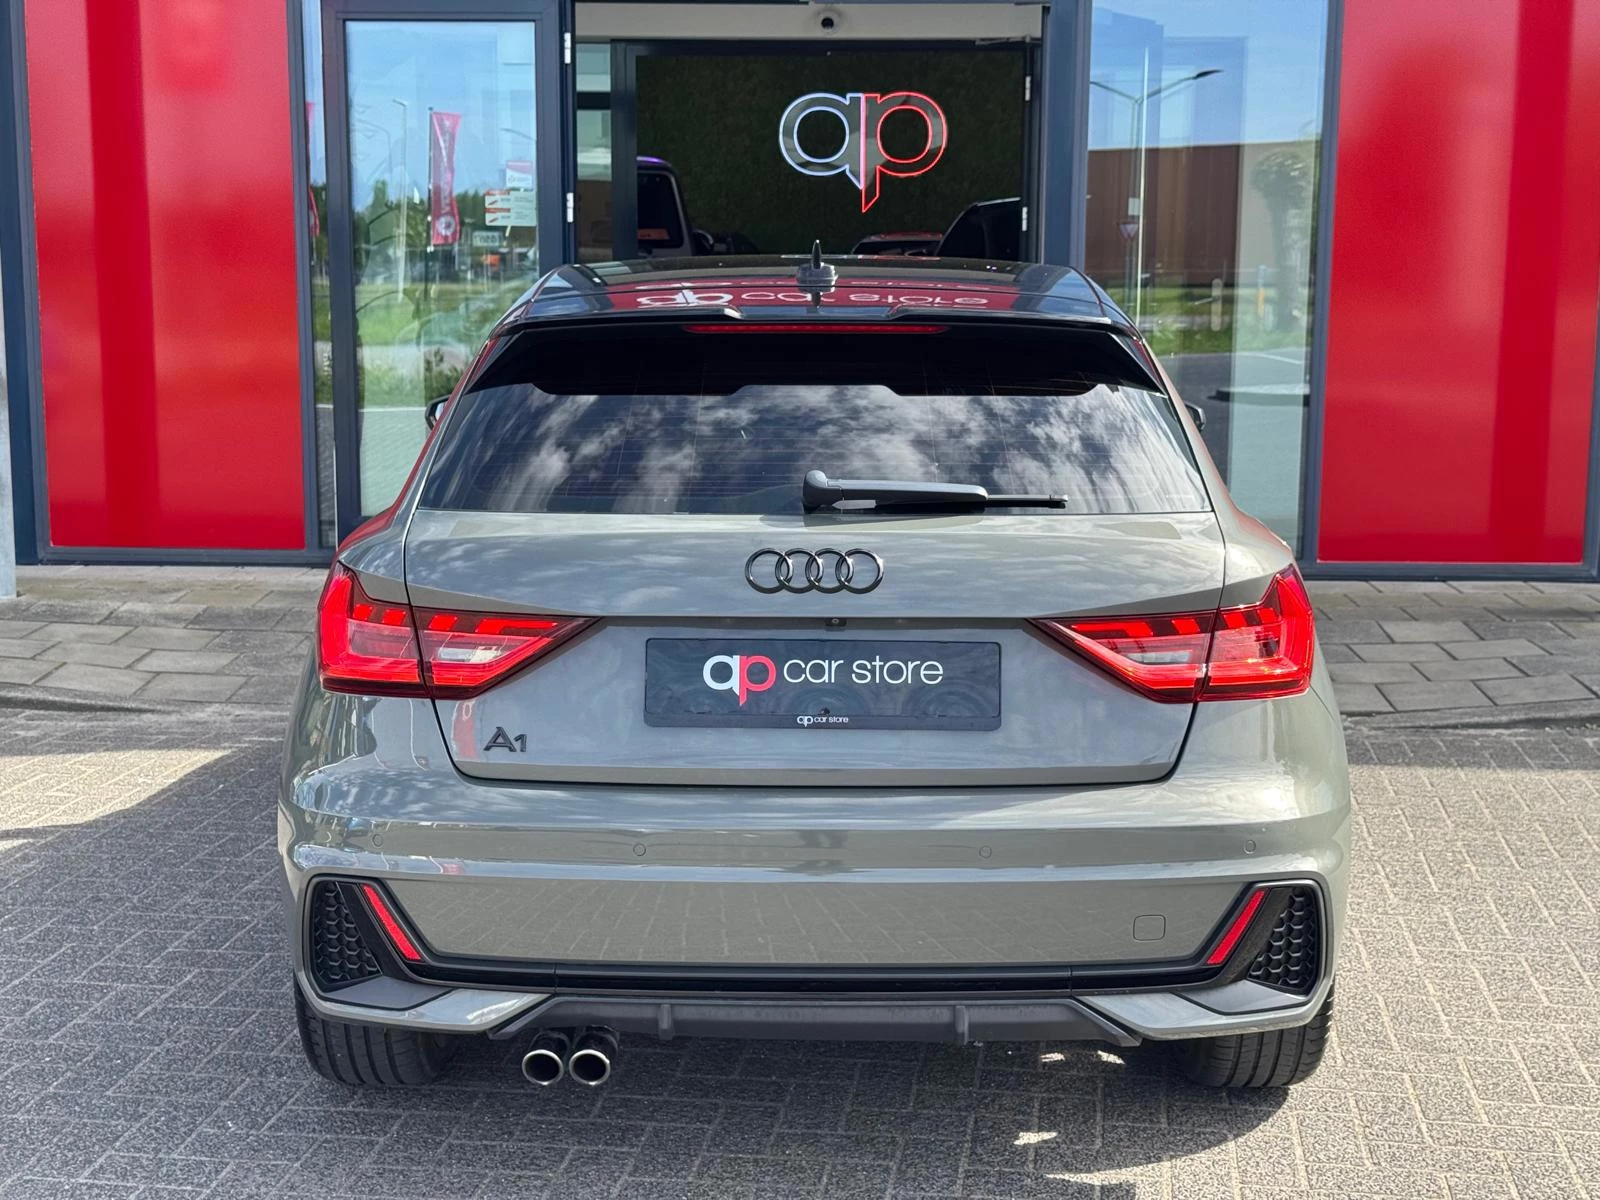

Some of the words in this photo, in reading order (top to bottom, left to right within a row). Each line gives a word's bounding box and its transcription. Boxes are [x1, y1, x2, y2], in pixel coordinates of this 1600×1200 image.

[783, 659, 844, 684] car
[851, 656, 944, 685] store
[483, 726, 528, 753] A1
